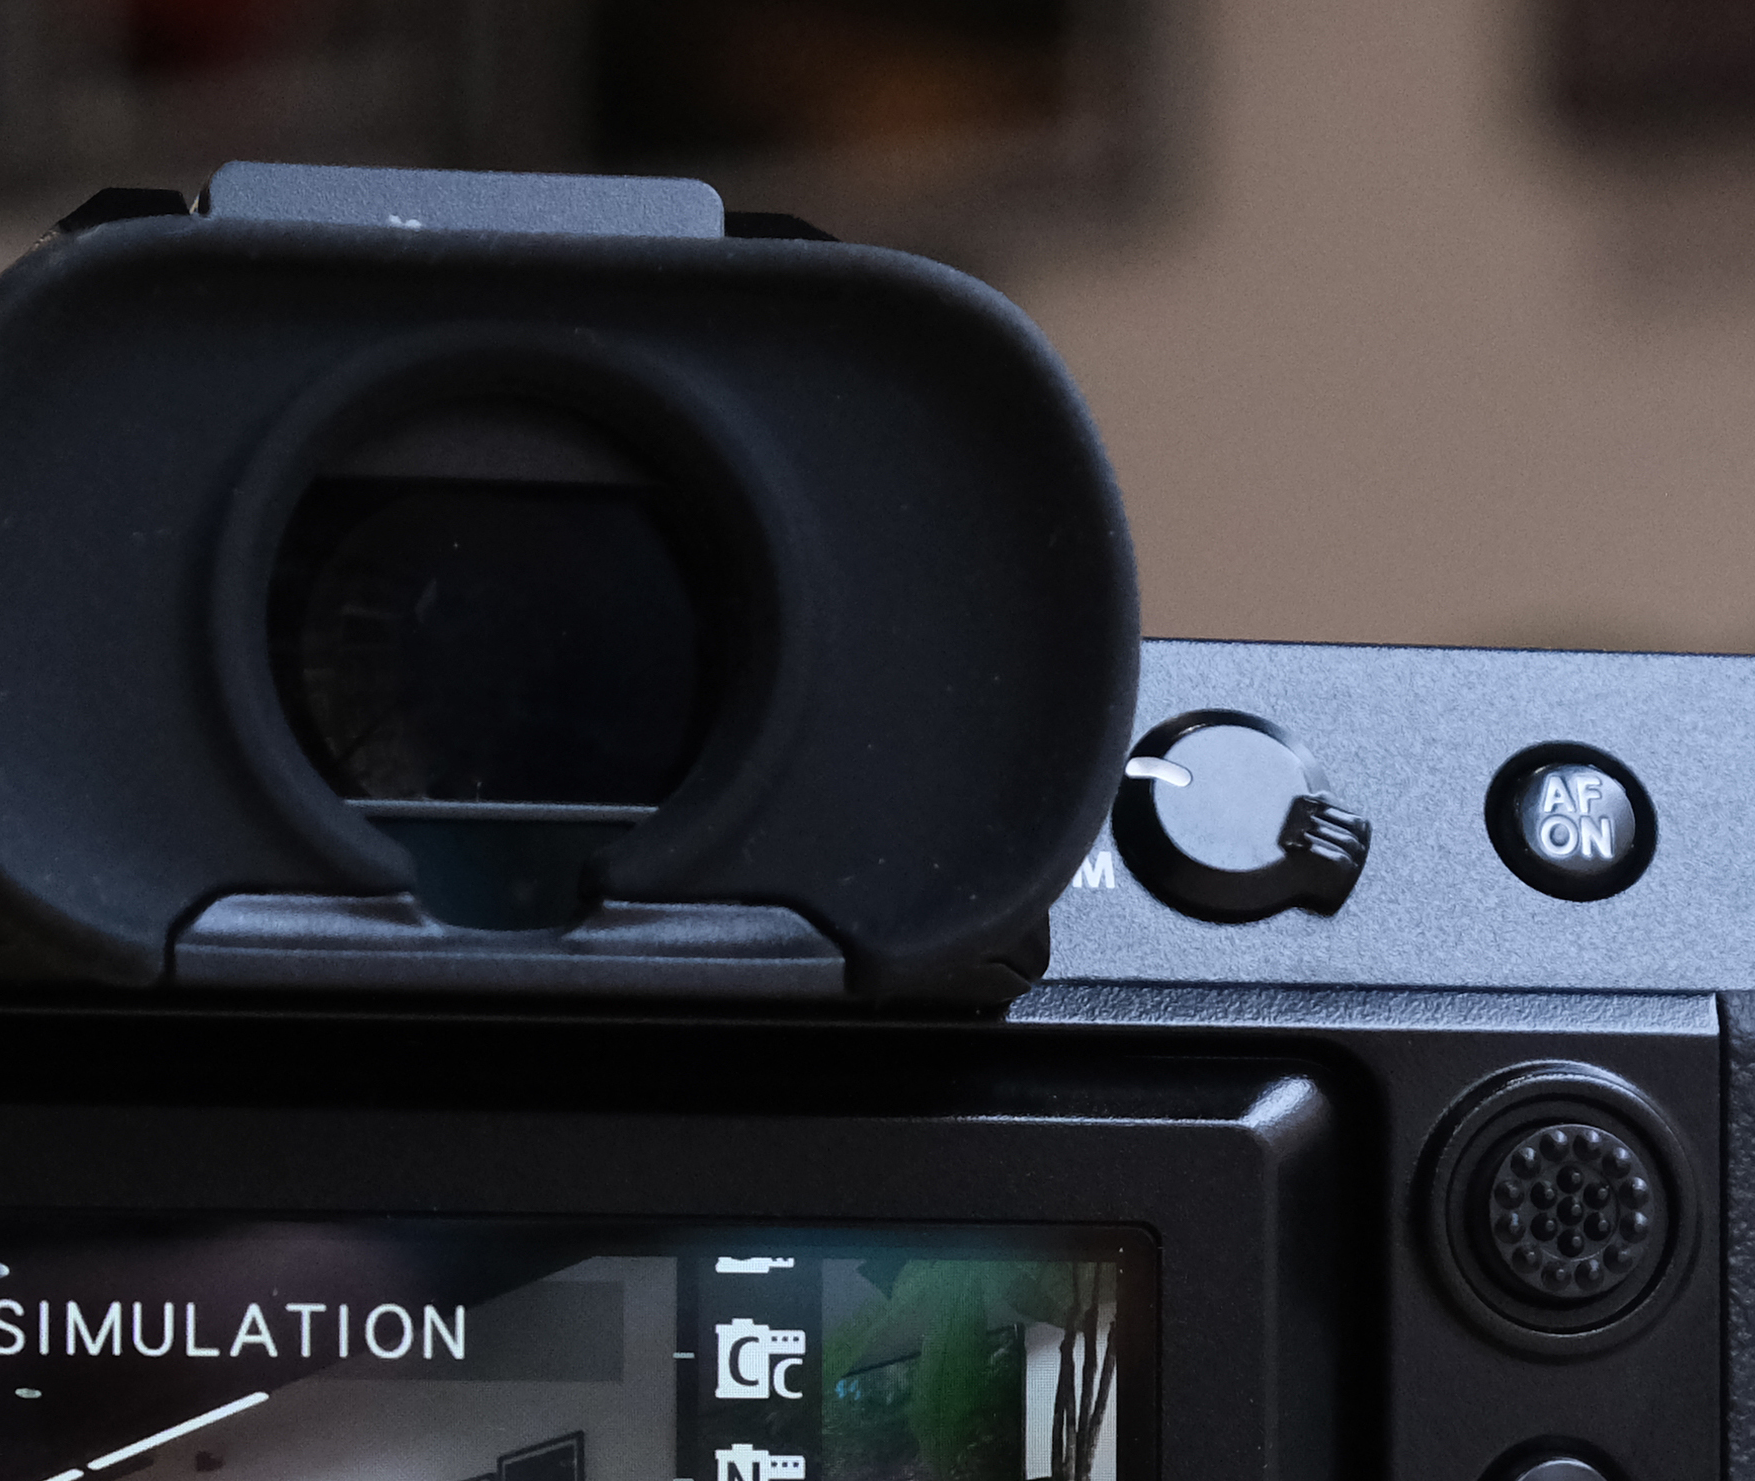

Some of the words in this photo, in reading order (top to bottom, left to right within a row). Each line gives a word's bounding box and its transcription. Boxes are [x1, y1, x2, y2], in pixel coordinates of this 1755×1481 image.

[1542, 773, 1604, 814] AF
[1536, 814, 1615, 860] ON
[1072, 850, 1116, 889] M
